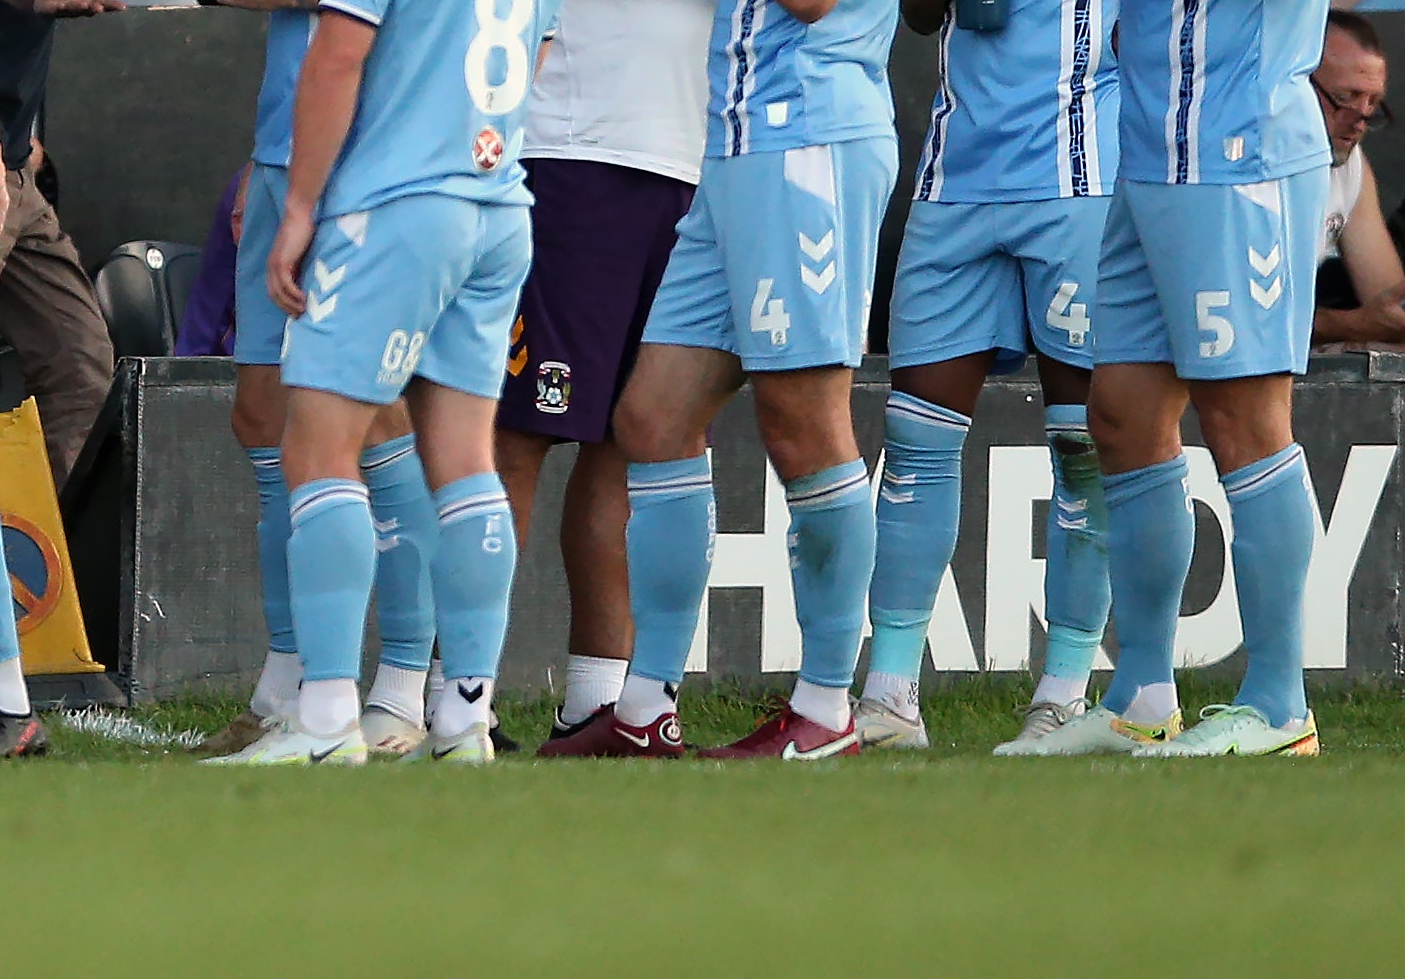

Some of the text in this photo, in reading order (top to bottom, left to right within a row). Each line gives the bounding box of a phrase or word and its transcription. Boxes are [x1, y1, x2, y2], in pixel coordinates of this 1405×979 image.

[749, 277, 790, 347] 4
[1046, 282, 1091, 347] 4
[1195, 290, 1235, 359] 5
